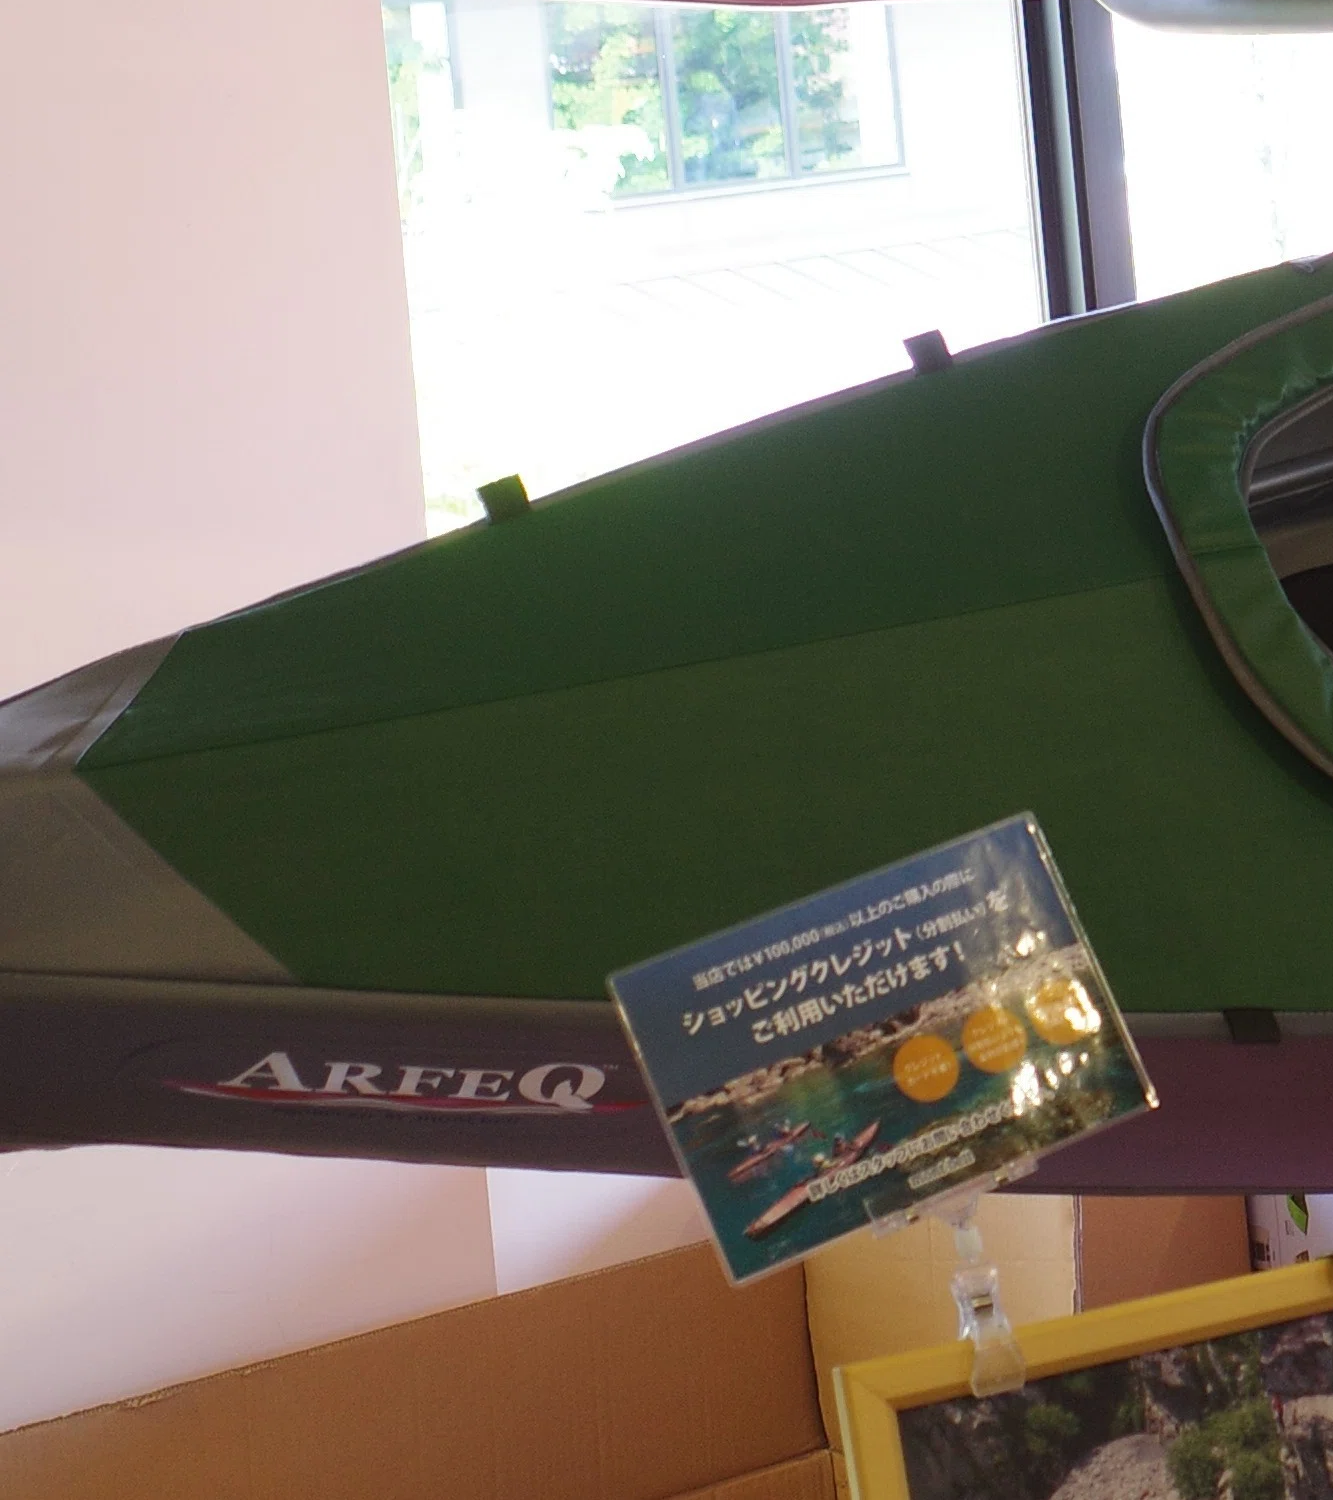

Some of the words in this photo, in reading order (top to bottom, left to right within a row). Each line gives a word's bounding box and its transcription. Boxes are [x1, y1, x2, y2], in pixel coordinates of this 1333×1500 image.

[751, 940, 966, 1044] ご利用いただけます!
[217, 1050, 605, 1110] ARFEQ
